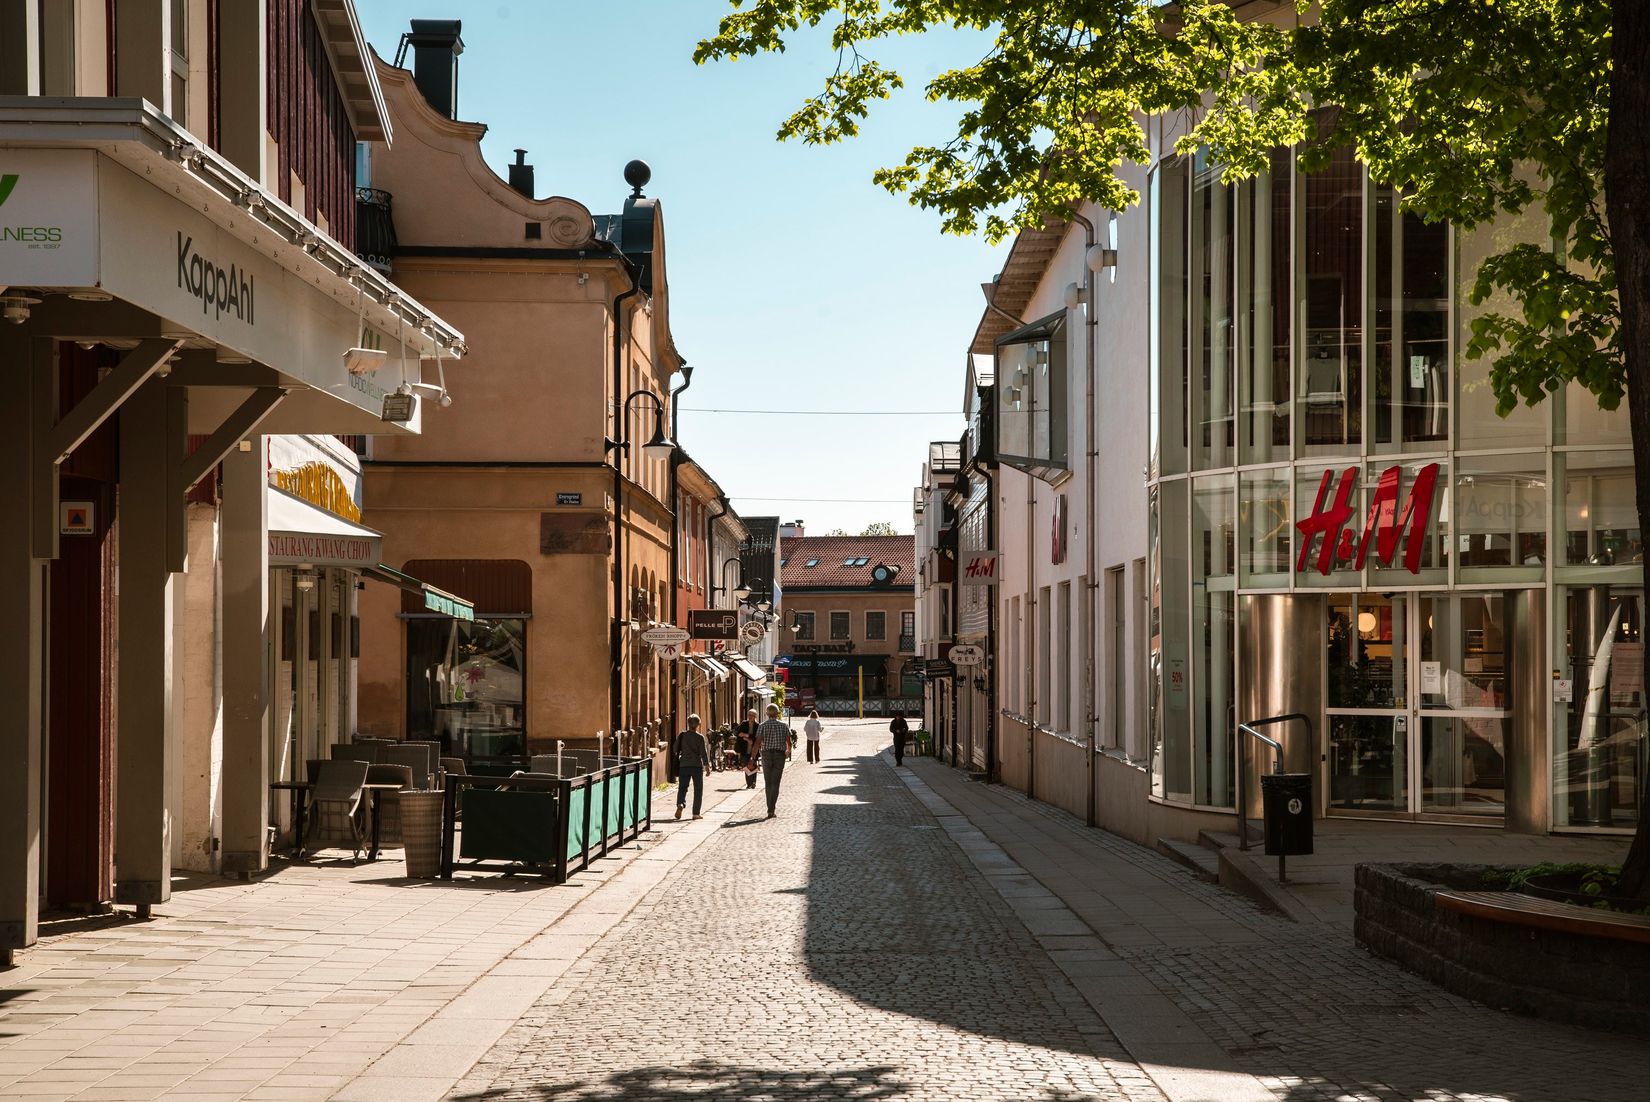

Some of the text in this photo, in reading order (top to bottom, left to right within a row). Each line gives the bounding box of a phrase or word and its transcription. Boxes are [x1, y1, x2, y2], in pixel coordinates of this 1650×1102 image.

[0, 227, 62, 241] NESS
[177, 230, 254, 326] KappAhl
[1295, 463, 1439, 576] H&M
[315, 538, 345, 560] KWANG
[346, 541, 371, 561] CHOW
[965, 557, 995, 578] H&M
